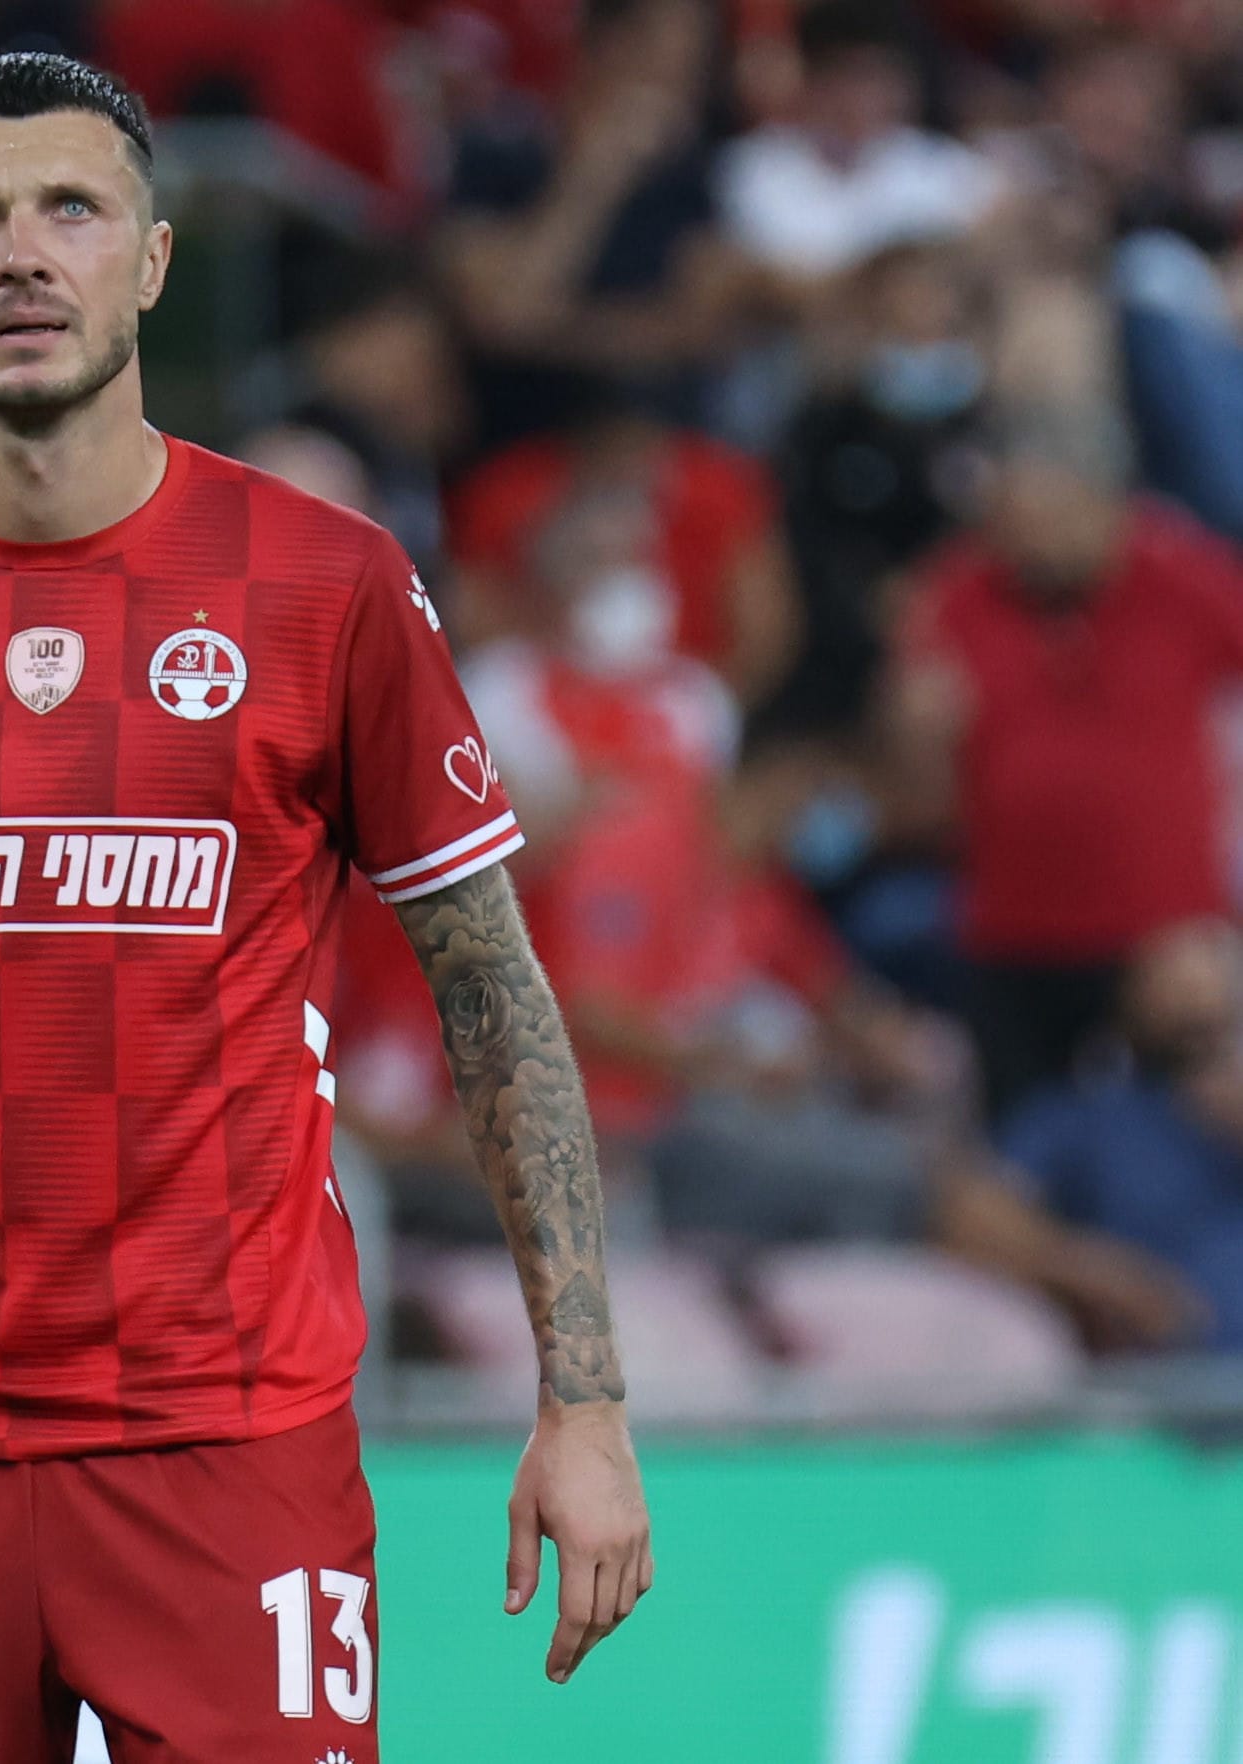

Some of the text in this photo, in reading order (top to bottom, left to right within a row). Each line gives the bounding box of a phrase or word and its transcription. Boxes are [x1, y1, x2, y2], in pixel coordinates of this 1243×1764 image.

[28, 638, 64, 659] 100
[42, 834, 220, 909] מחסני
[261, 1567, 374, 1725] 13
